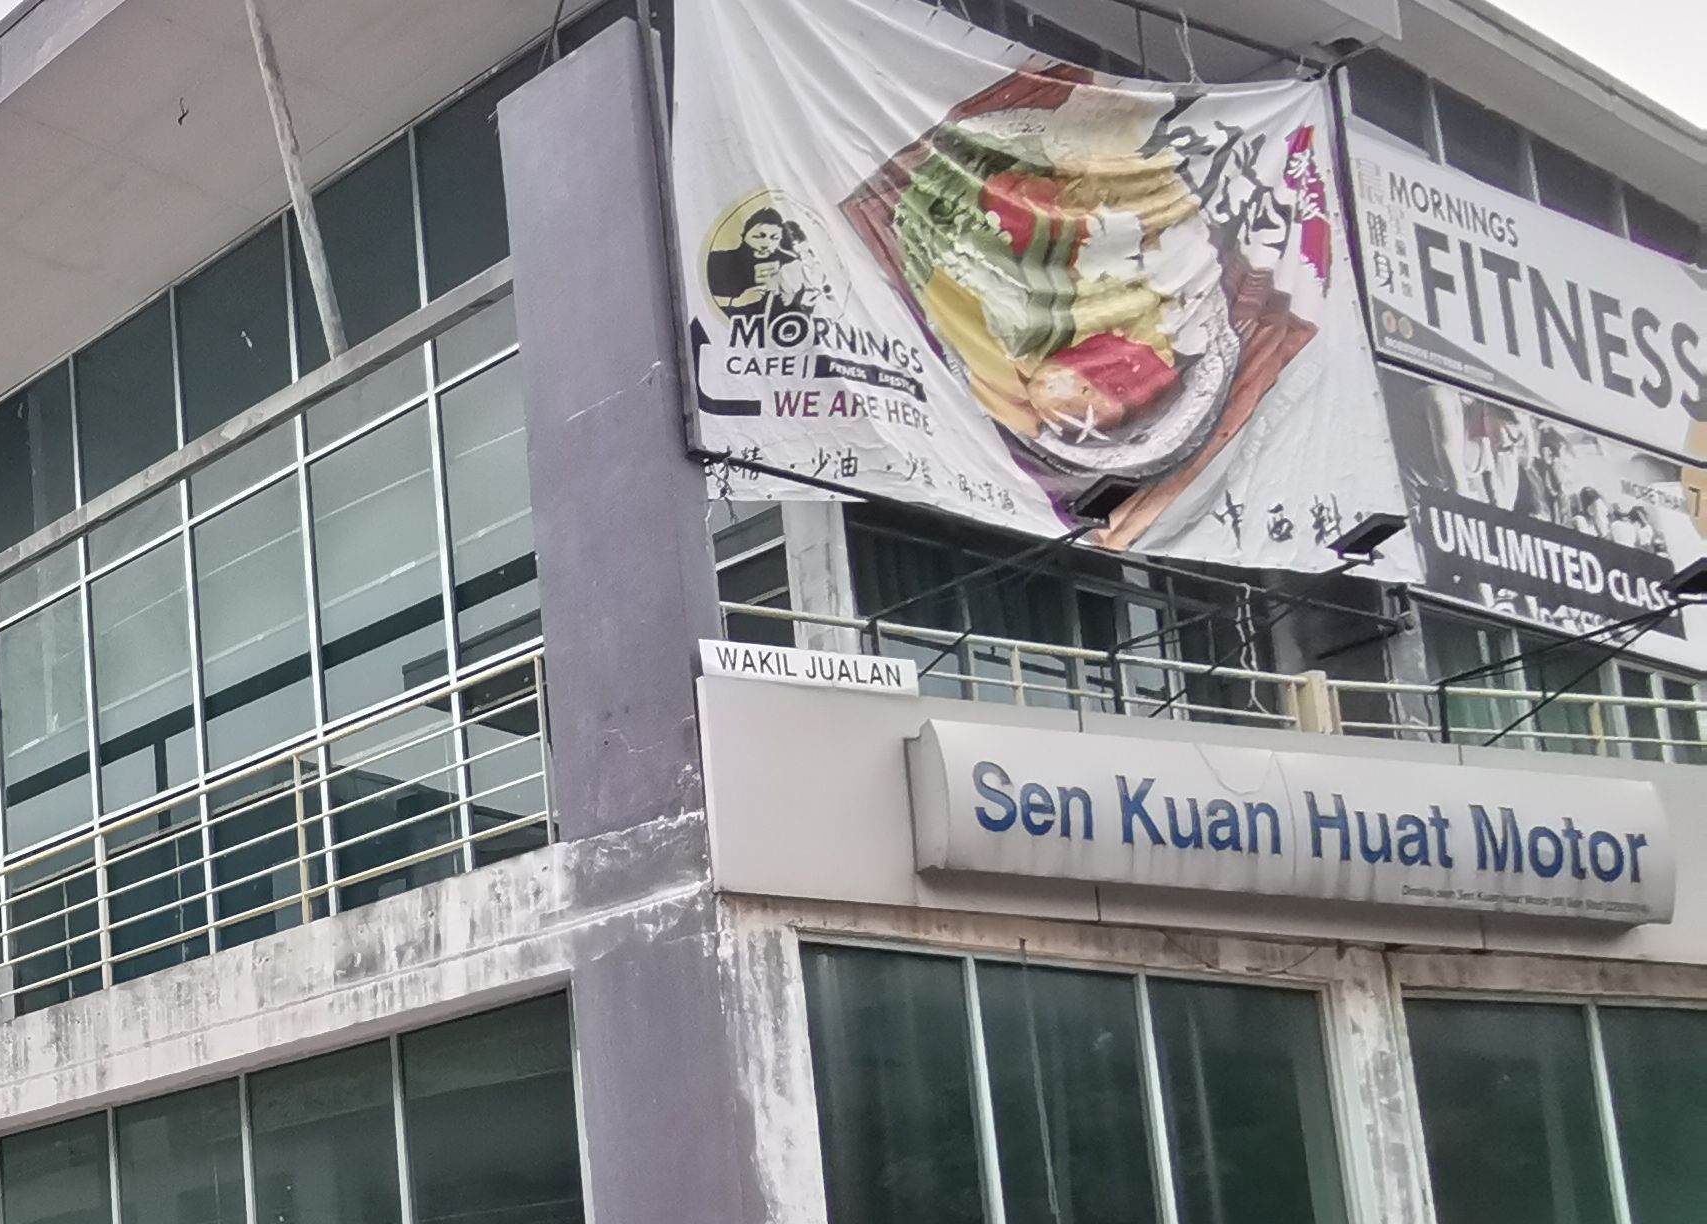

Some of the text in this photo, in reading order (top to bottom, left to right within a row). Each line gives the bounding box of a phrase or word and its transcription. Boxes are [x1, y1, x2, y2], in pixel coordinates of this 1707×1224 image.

[1388, 171, 1519, 248] MORNINGS
[728, 313, 924, 375] MORNINGS
[1413, 221, 1707, 422] FITNESS
[725, 355, 796, 378] CAFE
[773, 389, 935, 437] WE ARE HERE
[1428, 505, 1605, 595] UNLIMITED
[715, 646, 902, 688] WAKIL JUALAN
[973, 760, 1648, 884] Sen Kuan Huat Motor
